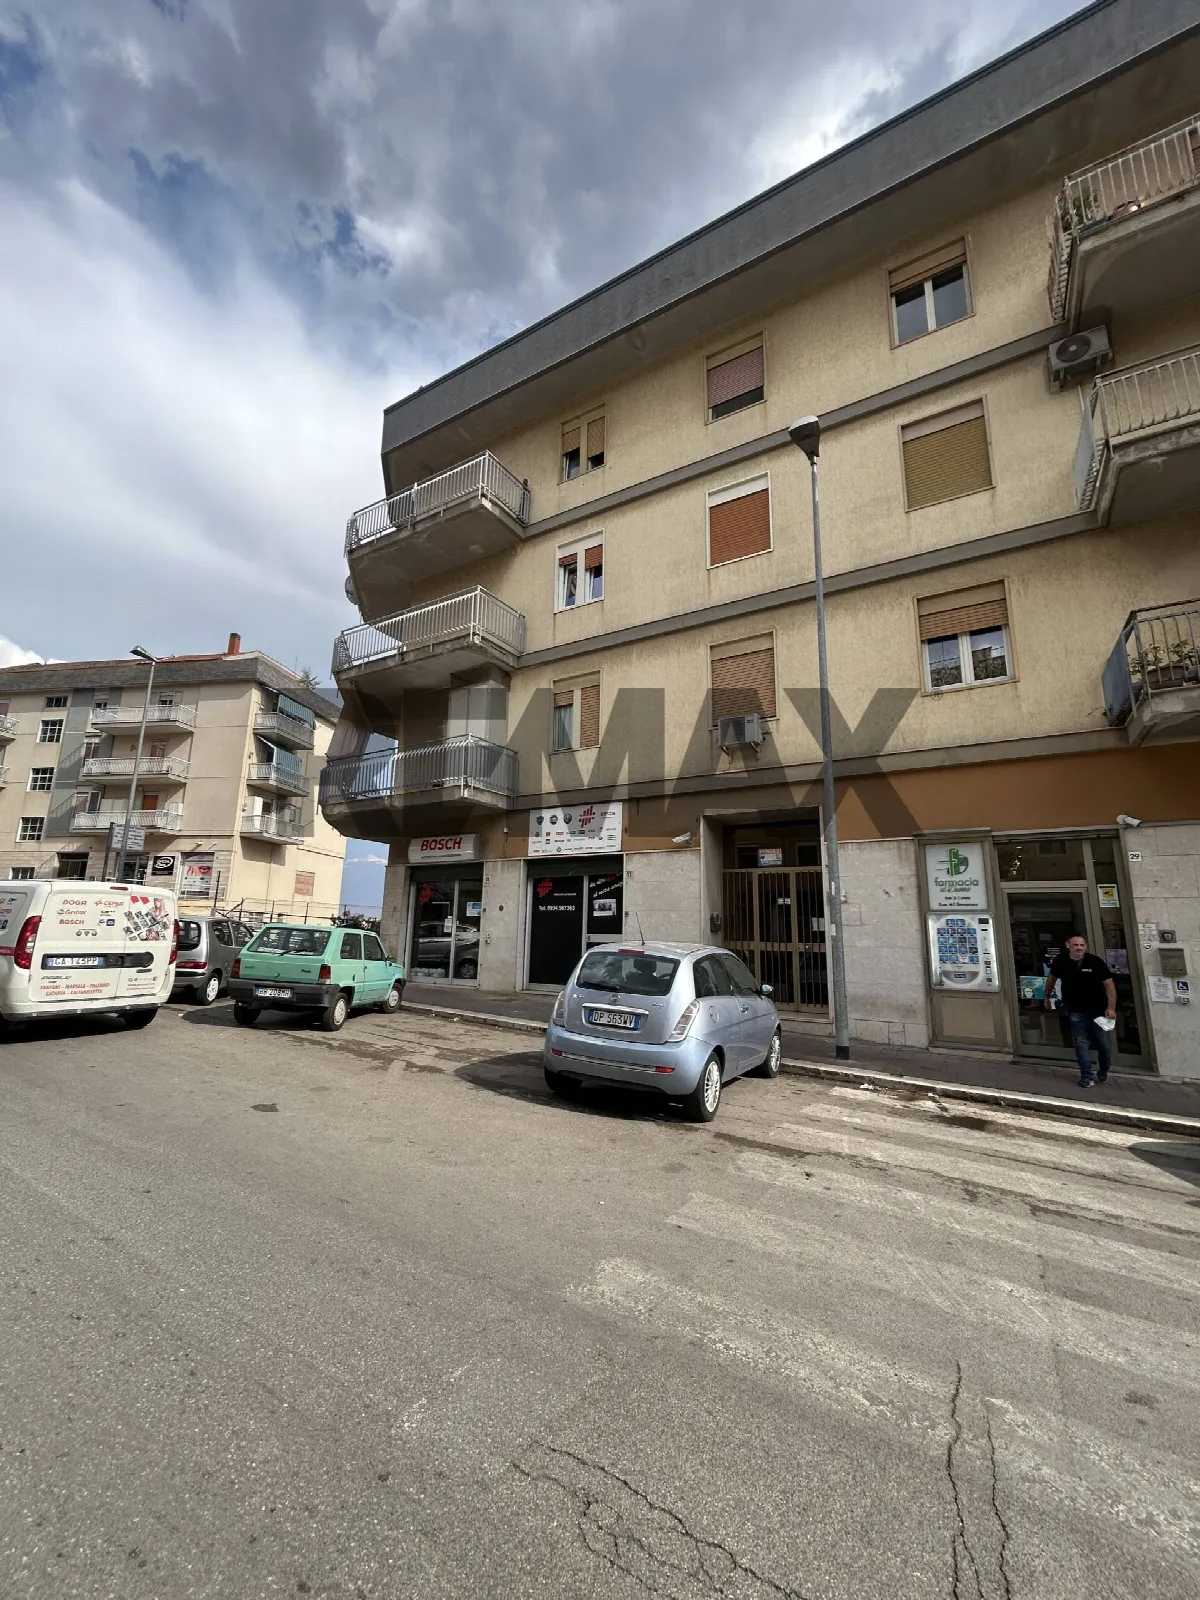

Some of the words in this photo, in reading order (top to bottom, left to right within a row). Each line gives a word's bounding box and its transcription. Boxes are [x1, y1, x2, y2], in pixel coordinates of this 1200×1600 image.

[421, 837, 462, 851] BOSCH
[934, 877, 979, 886] farmacia
[594, 1011, 604, 1022] DP
